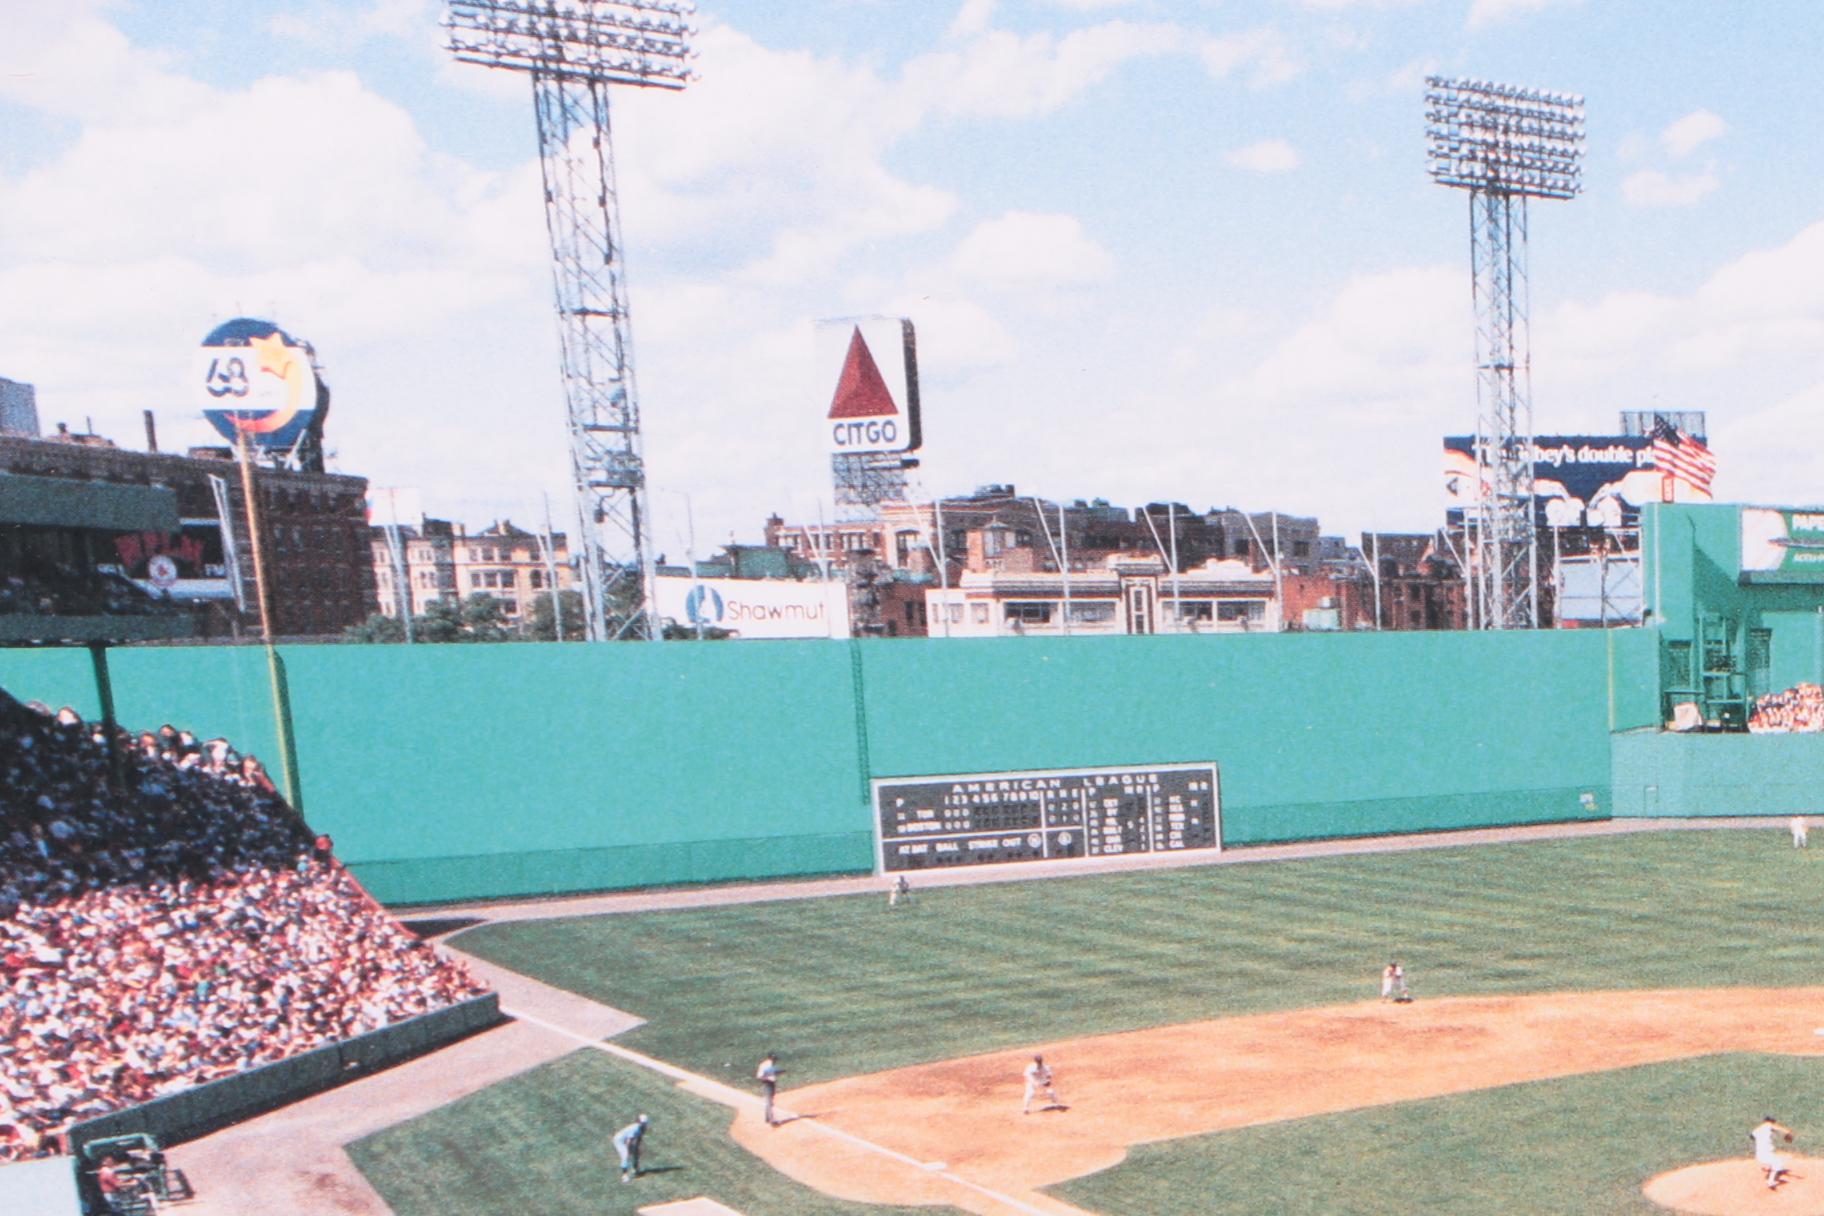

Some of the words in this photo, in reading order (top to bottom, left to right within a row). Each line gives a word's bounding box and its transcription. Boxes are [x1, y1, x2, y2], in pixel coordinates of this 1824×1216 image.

[206, 357, 249, 397] 68
[833, 419, 897, 446] CITGO
[1577, 445, 1634, 463] double
[727, 600, 824, 621] Shawmut
[952, 778, 1061, 793] AMERICAN
[1083, 774, 1158, 788] LEAGUE
[952, 795, 960, 805] 2
[961, 794, 968, 805] 3
[972, 794, 980, 804] 4
[982, 793, 990, 803] 5
[1003, 792, 1009, 802] 7
[1010, 792, 1018, 801] 8
[1019, 791, 1027, 801] 9
[1029, 790, 1040, 800] 10
[1071, 788, 1079, 798] E
[944, 808, 951, 818] 0
[953, 808, 960, 818] 0
[962, 808, 970, 817] 0
[906, 821, 942, 832] BOSTON
[944, 821, 952, 830] 0
[953, 820, 961, 830] 0
[962, 820, 970, 829] 0
[898, 845, 910, 855] AT
[911, 843, 928, 854] BAT
[935, 841, 959, 852] BALL
[968, 838, 999, 850] STRIKE
[1002, 837, 1022, 848] OUT
[1103, 844, 1123, 853] CLEV
[1169, 840, 1184, 849] CAL
